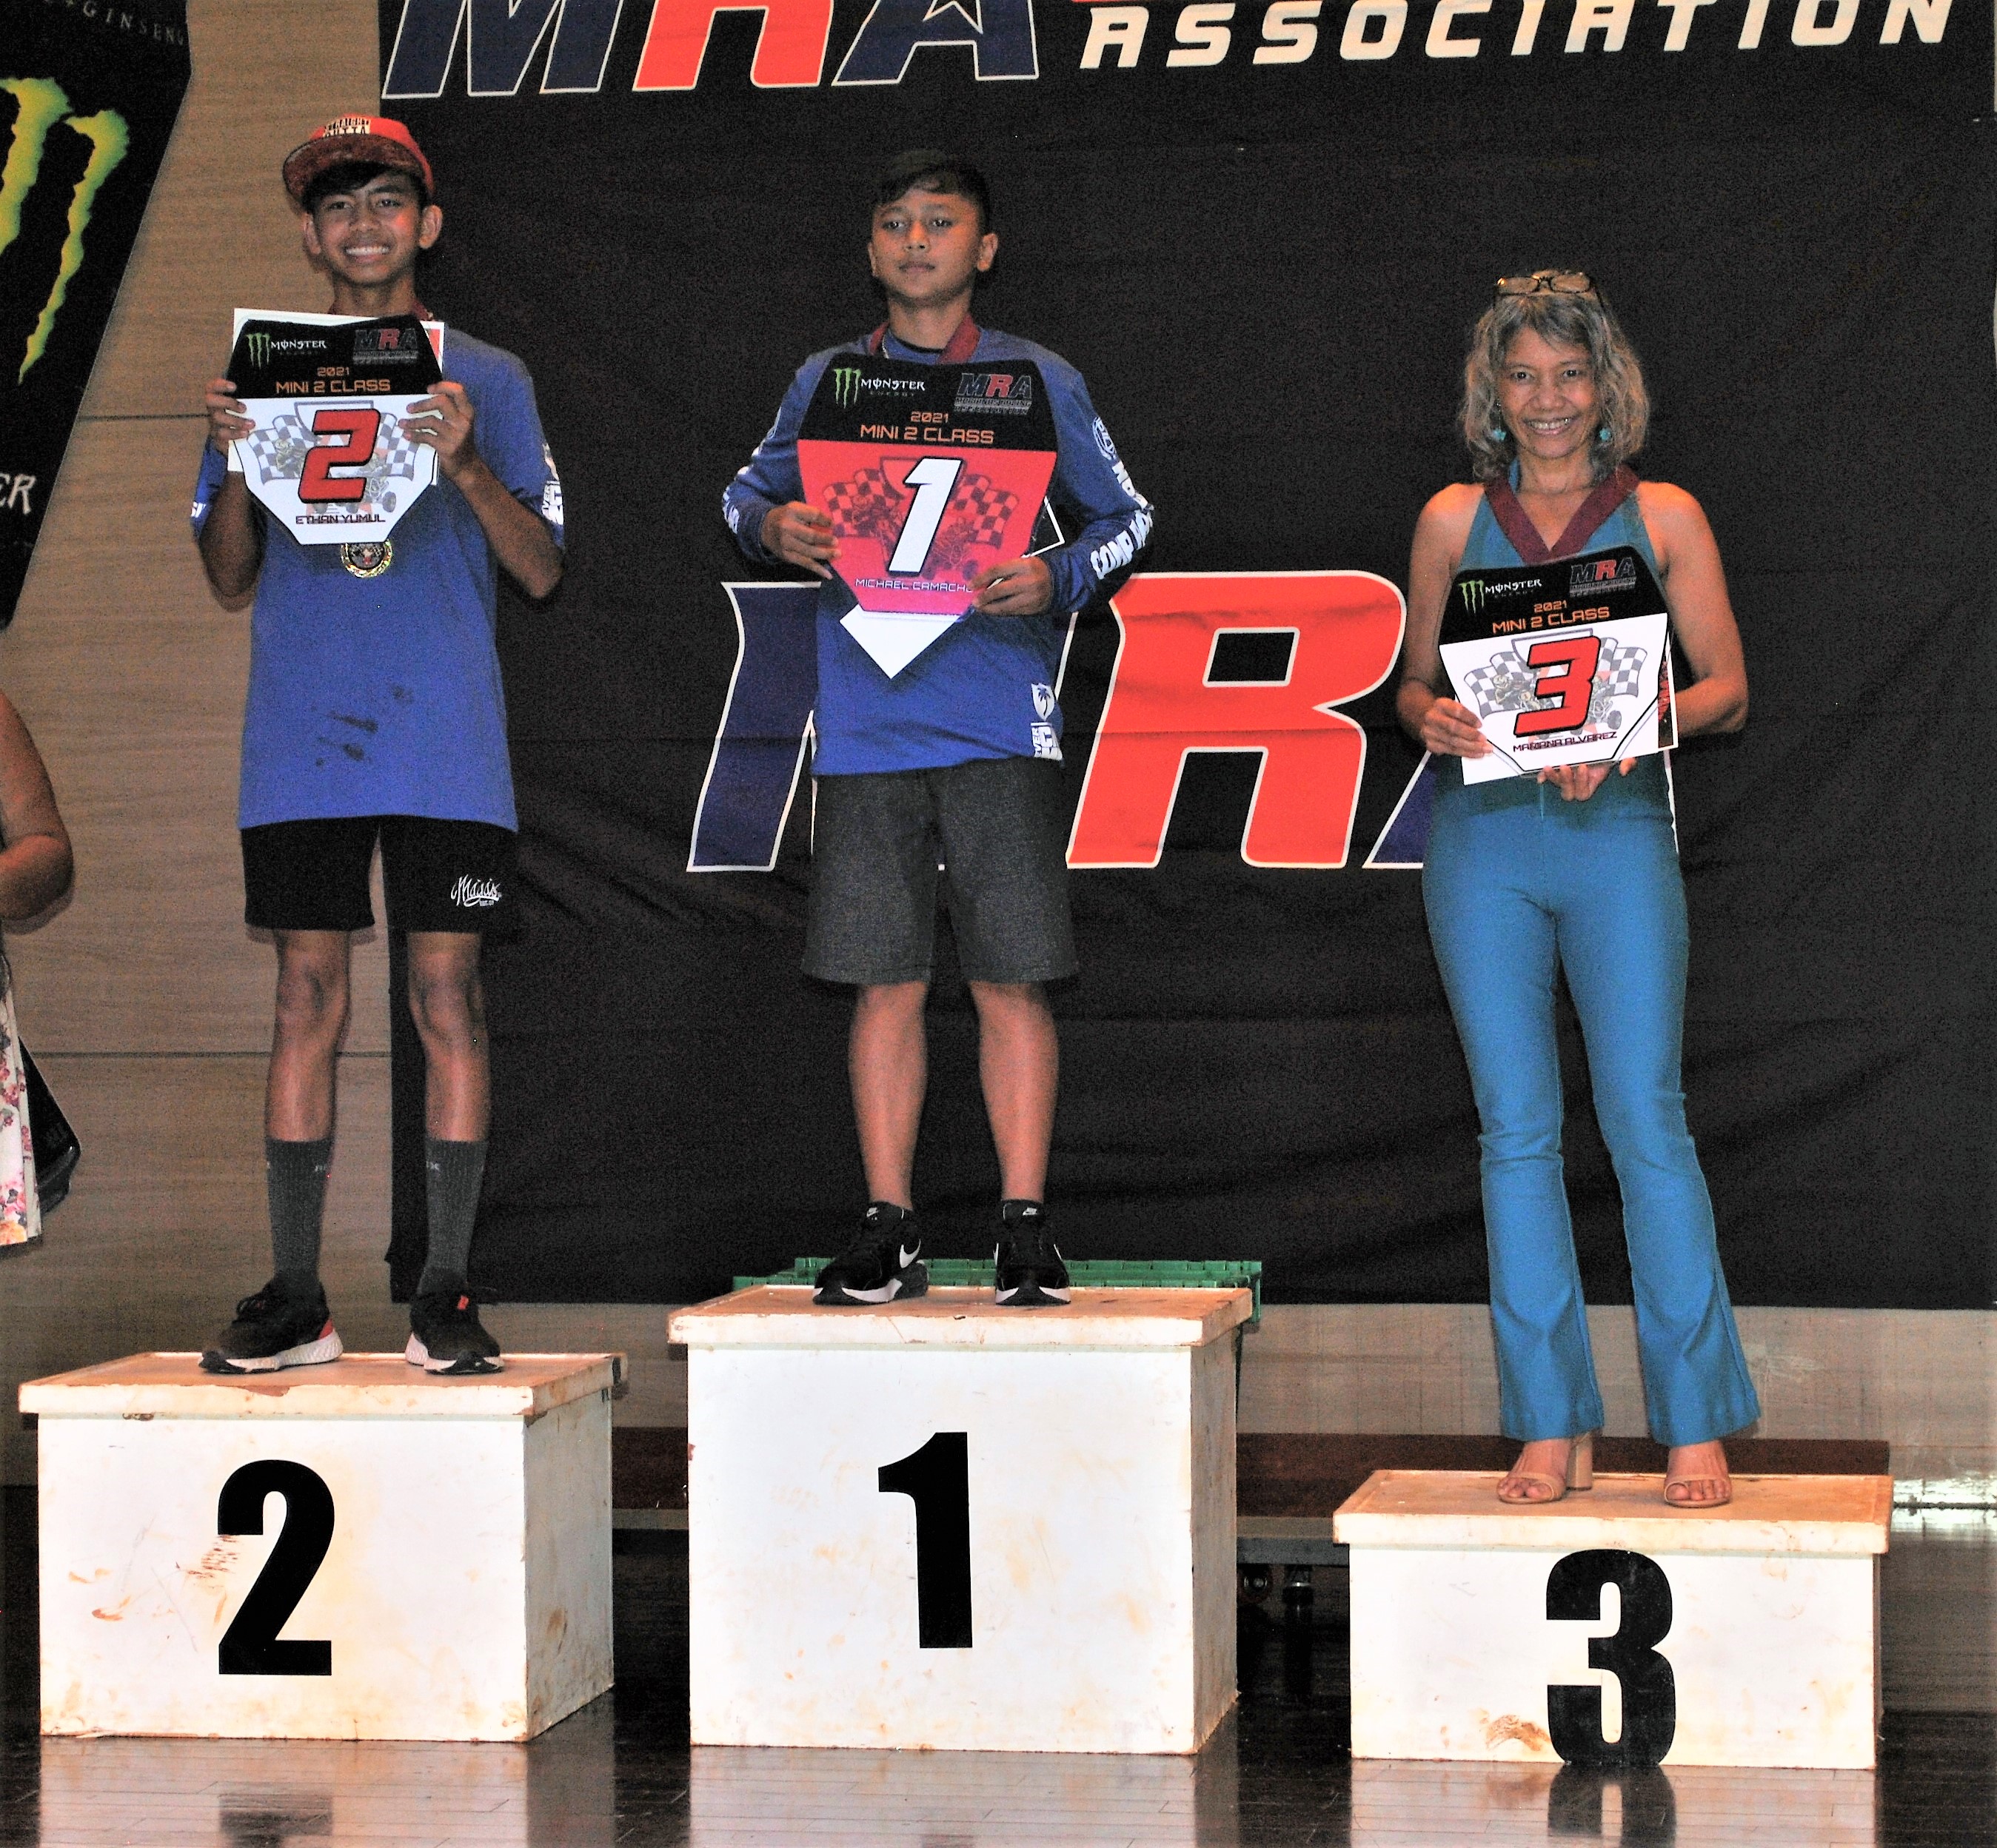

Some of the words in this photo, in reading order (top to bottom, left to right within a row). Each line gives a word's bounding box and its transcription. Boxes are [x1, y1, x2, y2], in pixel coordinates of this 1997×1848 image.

[1080, 0, 1953, 69] ASSOCIATION
[317, 366, 350, 377] 2021
[275, 382, 310, 394] MINI
[314, 381, 326, 393] 2
[330, 379, 391, 392] CLASS
[956, 372, 1032, 399] MRA
[910, 411, 949, 424] 2021
[860, 424, 899, 440] MINI
[903, 426, 919, 441] 2
[924, 427, 994, 444] CLASS
[298, 409, 381, 504] 2
[886, 456, 963, 577] 1
[855, 578, 909, 589] MICHAEL
[1569, 557, 1636, 584] MRA
[1492, 619, 1526, 634] MINI
[1531, 615, 1543, 628] 2
[1548, 606, 1610, 627] CLASS
[1533, 600, 1568, 613] 2021
[1513, 635, 1601, 737] 3
[877, 1431, 973, 1649] 1
[218, 1459, 335, 1676] 2
[1545, 1548, 1676, 1766] 3
